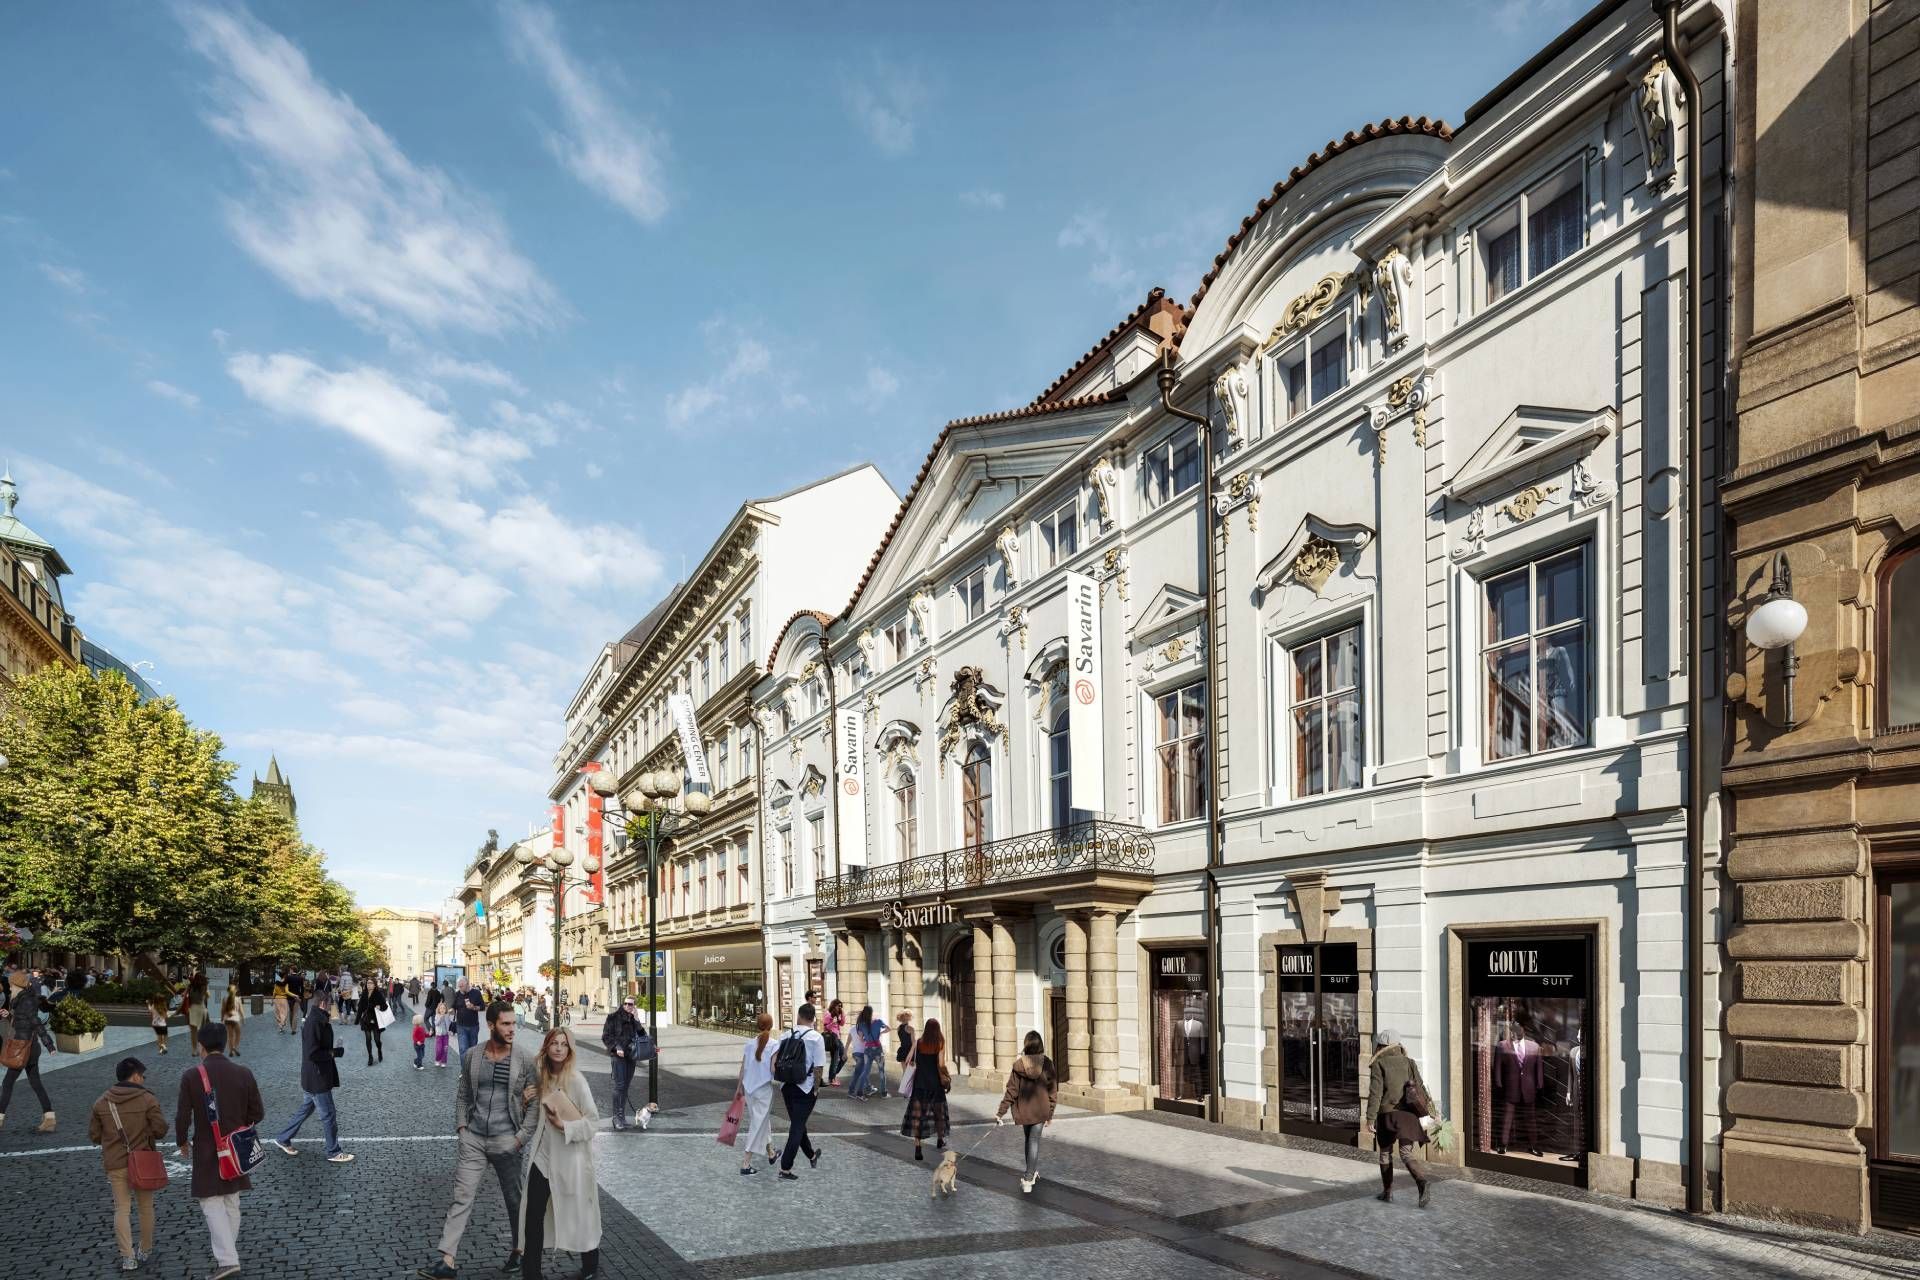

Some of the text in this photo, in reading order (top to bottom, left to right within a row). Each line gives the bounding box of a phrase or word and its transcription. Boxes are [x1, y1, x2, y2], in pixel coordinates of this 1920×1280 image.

[1075, 584, 1093, 674] Savarin
[843, 715, 858, 775] Savarin
[692, 744, 706, 777] CENTER
[893, 896, 953, 928] Savarin
[704, 953, 726, 965] juice
[1161, 957, 1186, 974] GOUVE
[1282, 955, 1313, 974] GOUVE
[1489, 950, 1538, 974] GOUVE
[1330, 976, 1350, 984] SUIT
[1542, 977, 1571, 986] SUIT
